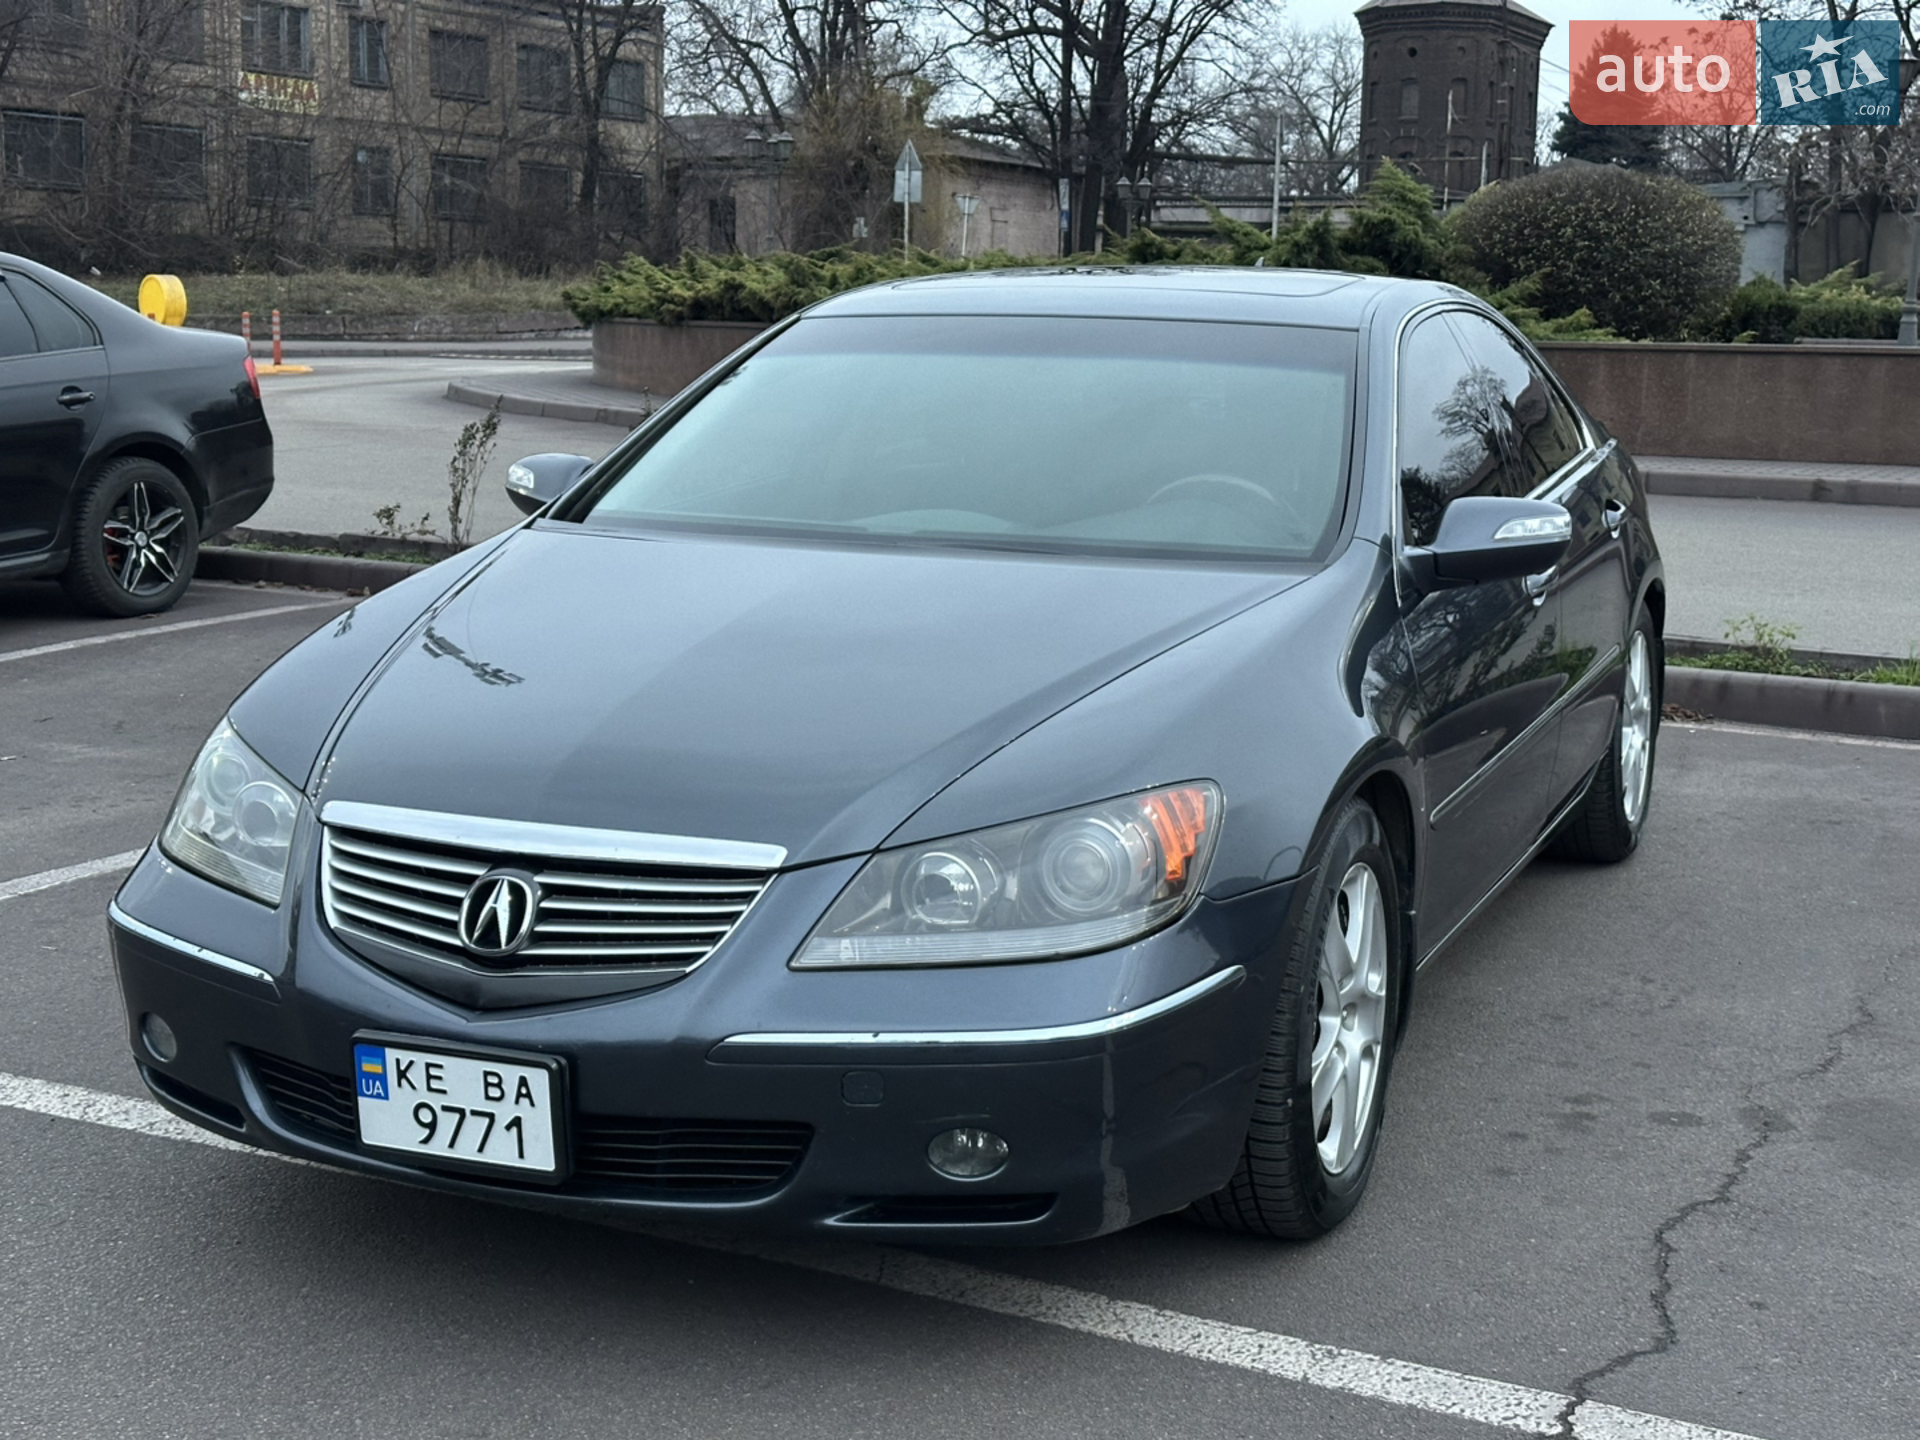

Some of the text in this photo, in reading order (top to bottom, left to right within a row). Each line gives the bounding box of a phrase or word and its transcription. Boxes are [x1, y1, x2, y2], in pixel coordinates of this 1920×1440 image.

[362, 1078, 385, 1097] UA
[395, 1057, 535, 1108] KE BA
[412, 1101, 525, 1159] 9771
